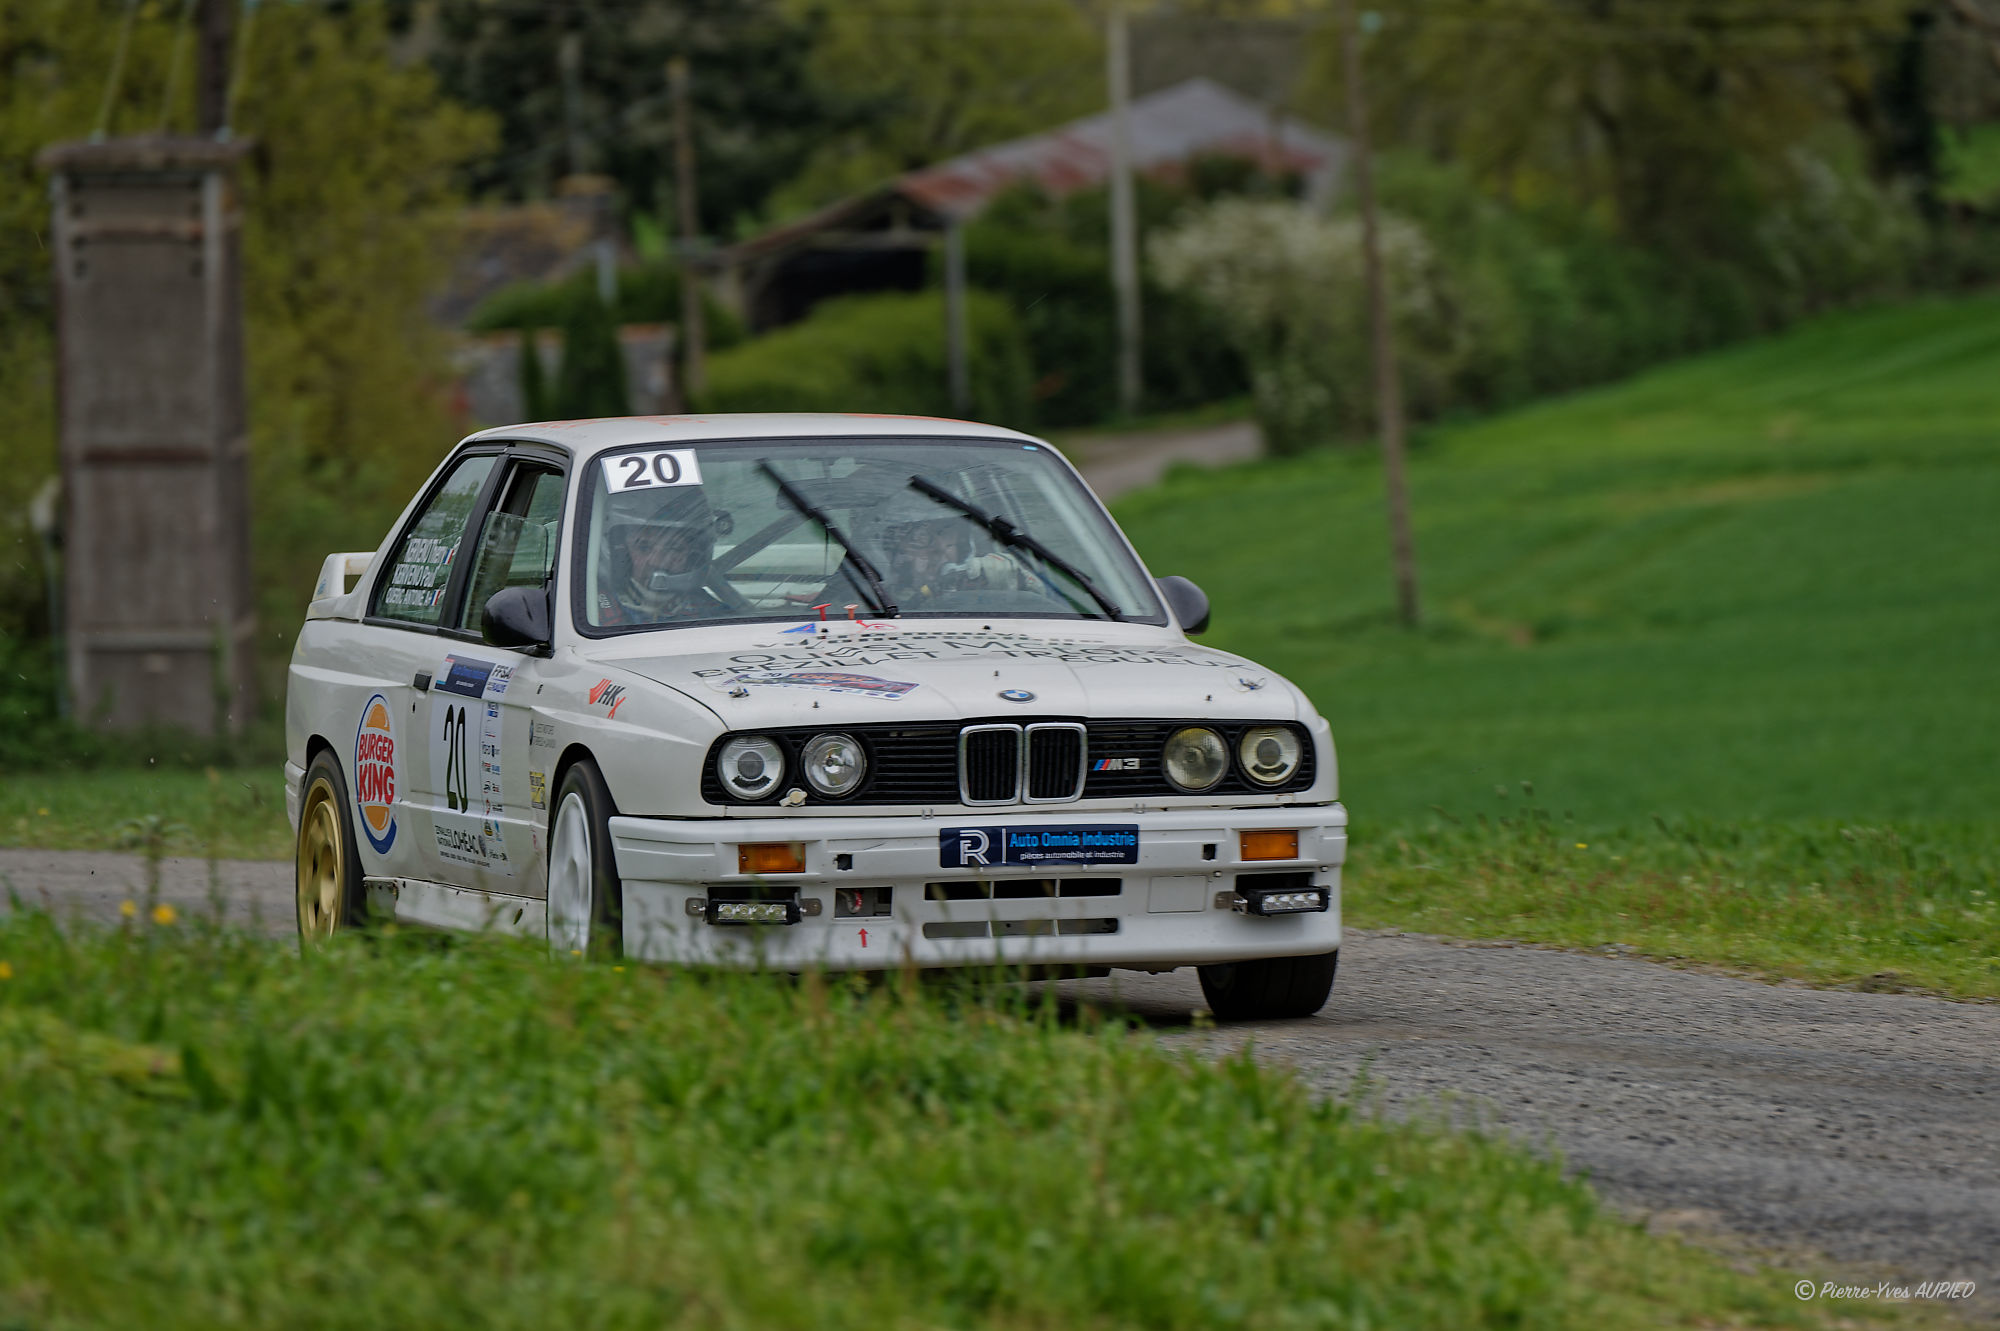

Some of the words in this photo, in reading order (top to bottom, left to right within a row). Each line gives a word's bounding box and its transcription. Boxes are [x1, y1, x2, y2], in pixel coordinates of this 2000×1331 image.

[619, 453, 682, 488] 20
[358, 734, 394, 766] BURGER
[443, 704, 469, 814] 20
[1104, 758, 1140, 770] M3
[358, 764, 395, 805] KING
[1009, 832, 1039, 848] Auto
[1041, 832, 1079, 847] Omnia
[1082, 831, 1136, 847] Industrie
[1094, 850, 1125, 858] industrie
